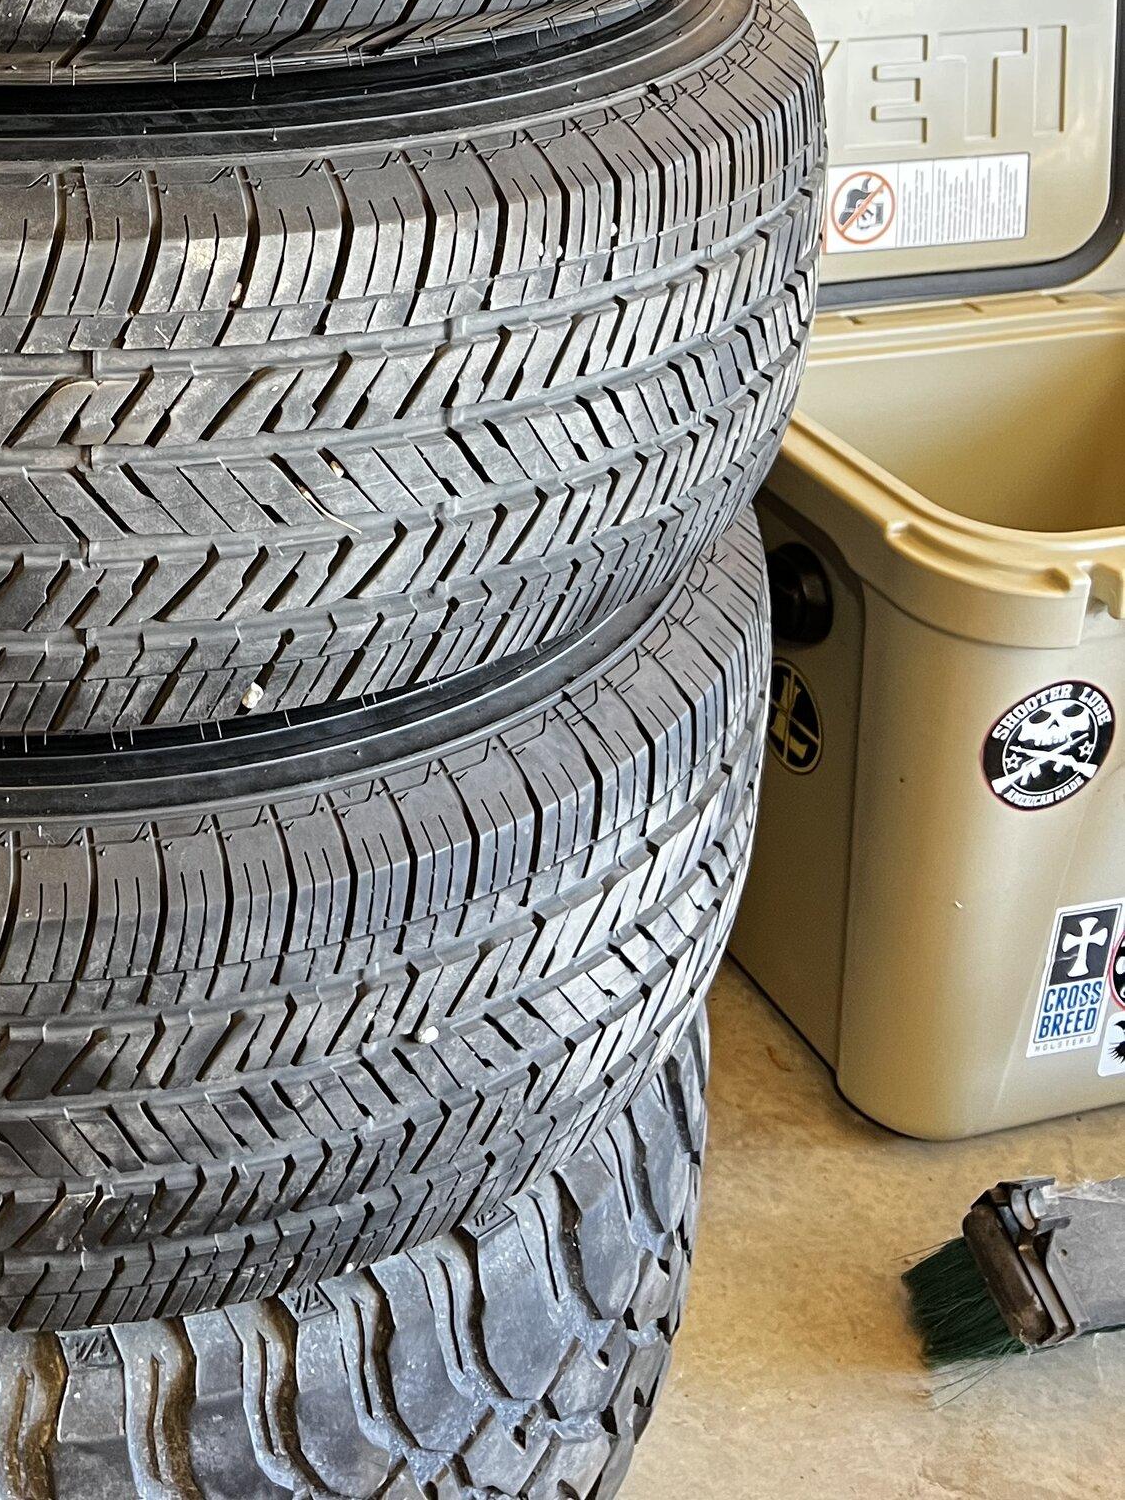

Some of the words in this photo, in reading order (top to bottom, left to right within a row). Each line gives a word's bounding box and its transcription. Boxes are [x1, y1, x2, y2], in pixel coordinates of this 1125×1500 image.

[992, 684, 1074, 741] SHOOTER
[1079, 686, 1112, 726] LUBE
[1003, 788, 1055, 807] AMERICAN
[1055, 775, 1084, 800] MADE
[1043, 980, 1103, 1013] CROSS
[1038, 1007, 1097, 1039] BREED
